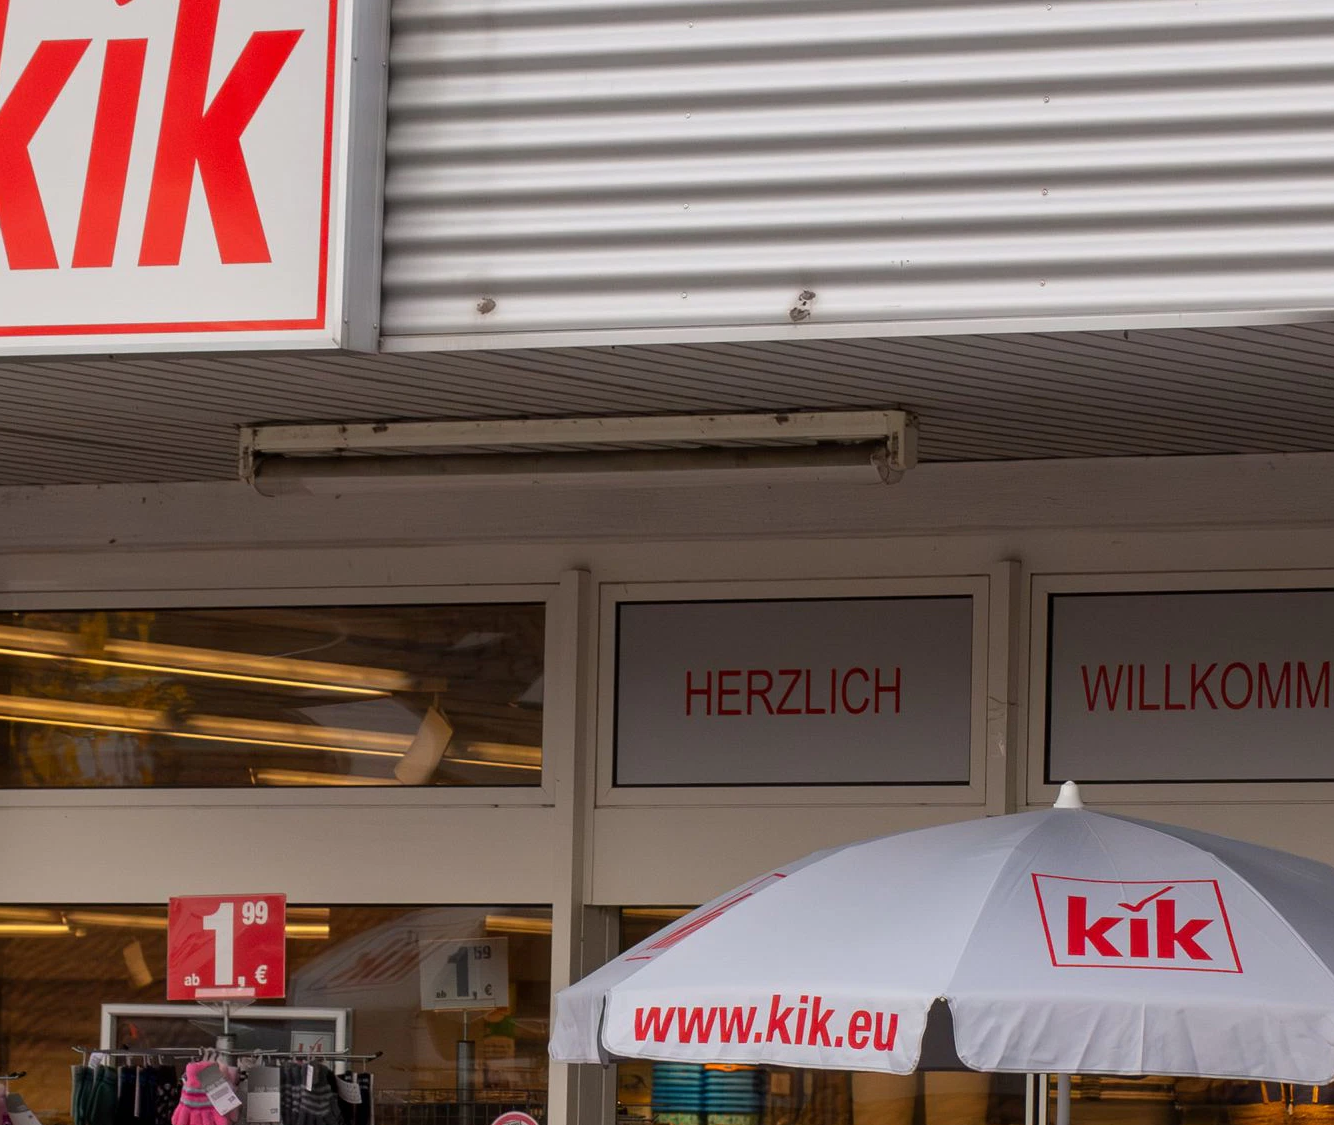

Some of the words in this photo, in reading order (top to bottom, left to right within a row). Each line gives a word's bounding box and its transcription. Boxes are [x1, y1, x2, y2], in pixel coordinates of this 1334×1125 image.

[685, 666, 901, 717] HERZLICH
[1066, 886, 1214, 961] kik
[184, 973, 200, 986] ab
[255, 964, 268, 984] €
[635, 994, 898, 1051] www.kik.eu
